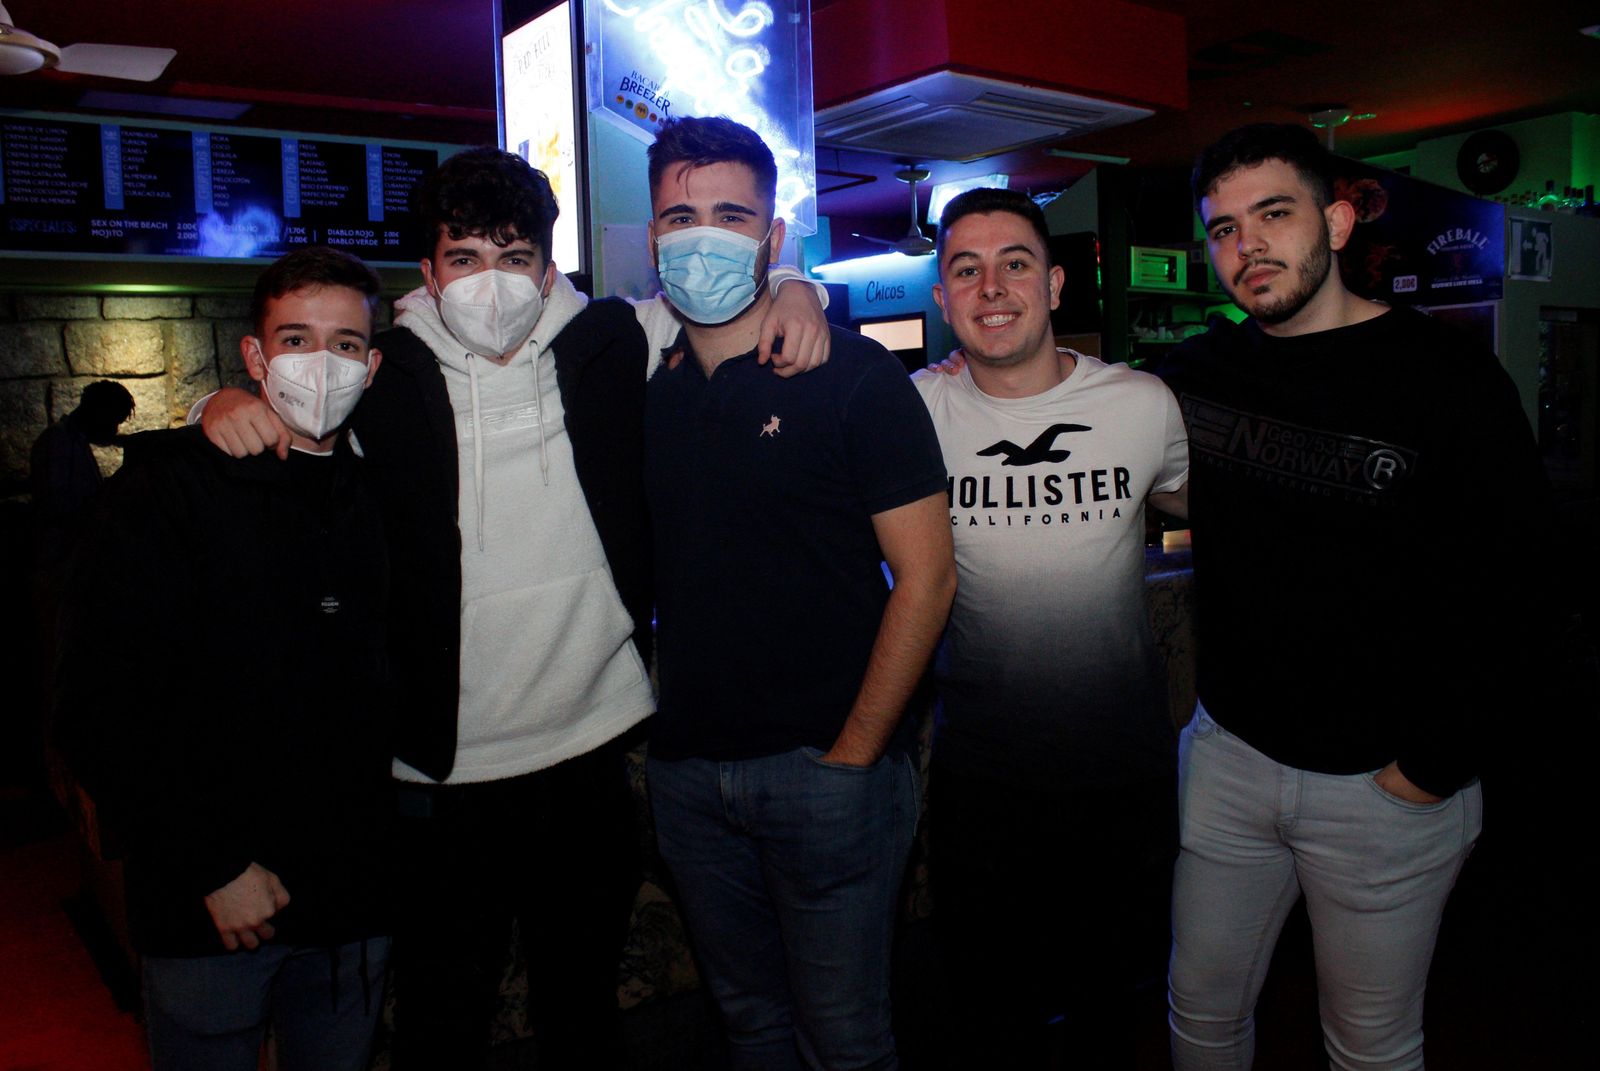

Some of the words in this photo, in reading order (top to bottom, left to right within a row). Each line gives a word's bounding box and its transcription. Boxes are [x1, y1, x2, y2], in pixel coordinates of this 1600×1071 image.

[619, 76, 671, 116] BREEZER
[91, 219, 107, 227] SEX
[109, 219, 123, 228] ON
[124, 220, 139, 229] THE
[141, 221, 168, 230] BEACH
[91, 229, 124, 239] MOJITO
[327, 228, 354, 237] DIABLO
[355, 229, 374, 239] ROJO
[1427, 227, 1489, 255] FIREBALL
[327, 237, 354, 246] DIABLO
[356, 238, 378, 247] VERDE
[866, 280, 905, 303] Chicos
[951, 507, 1121, 527] CALIFORNIA
